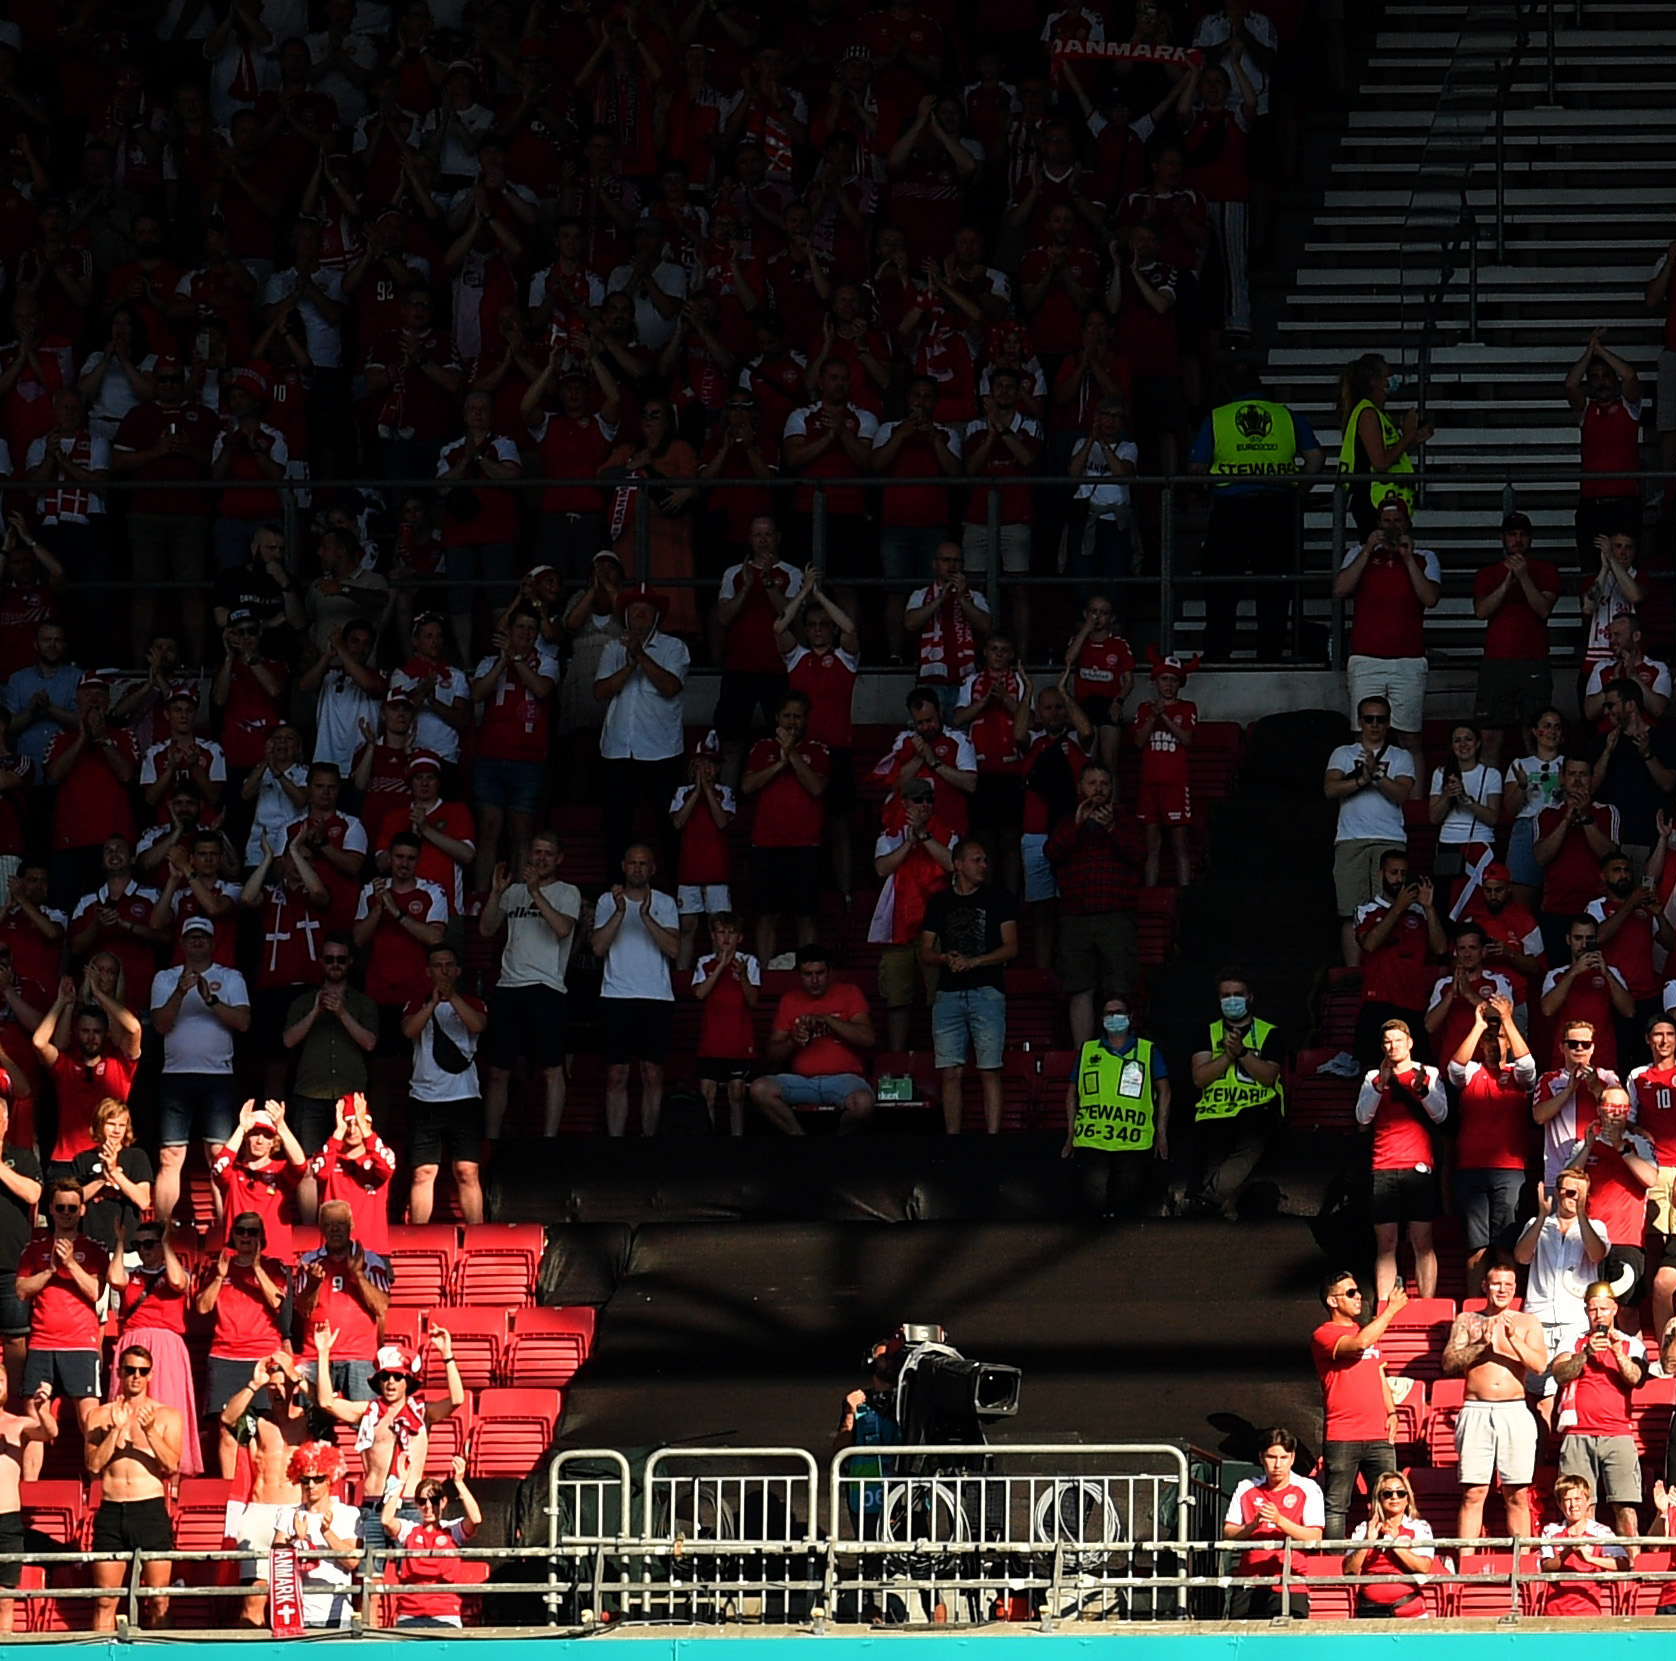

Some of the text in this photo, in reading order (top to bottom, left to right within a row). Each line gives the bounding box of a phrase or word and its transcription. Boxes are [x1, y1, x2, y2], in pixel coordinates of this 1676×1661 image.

[377, 281, 394, 301] 92
[274, 384, 287, 402] 10
[1656, 1089, 1671, 1109] 10
[1076, 1104, 1146, 1128] STEWARD
[333, 1276, 343, 1292] 9
[275, 1549, 294, 1606] ANMARK
